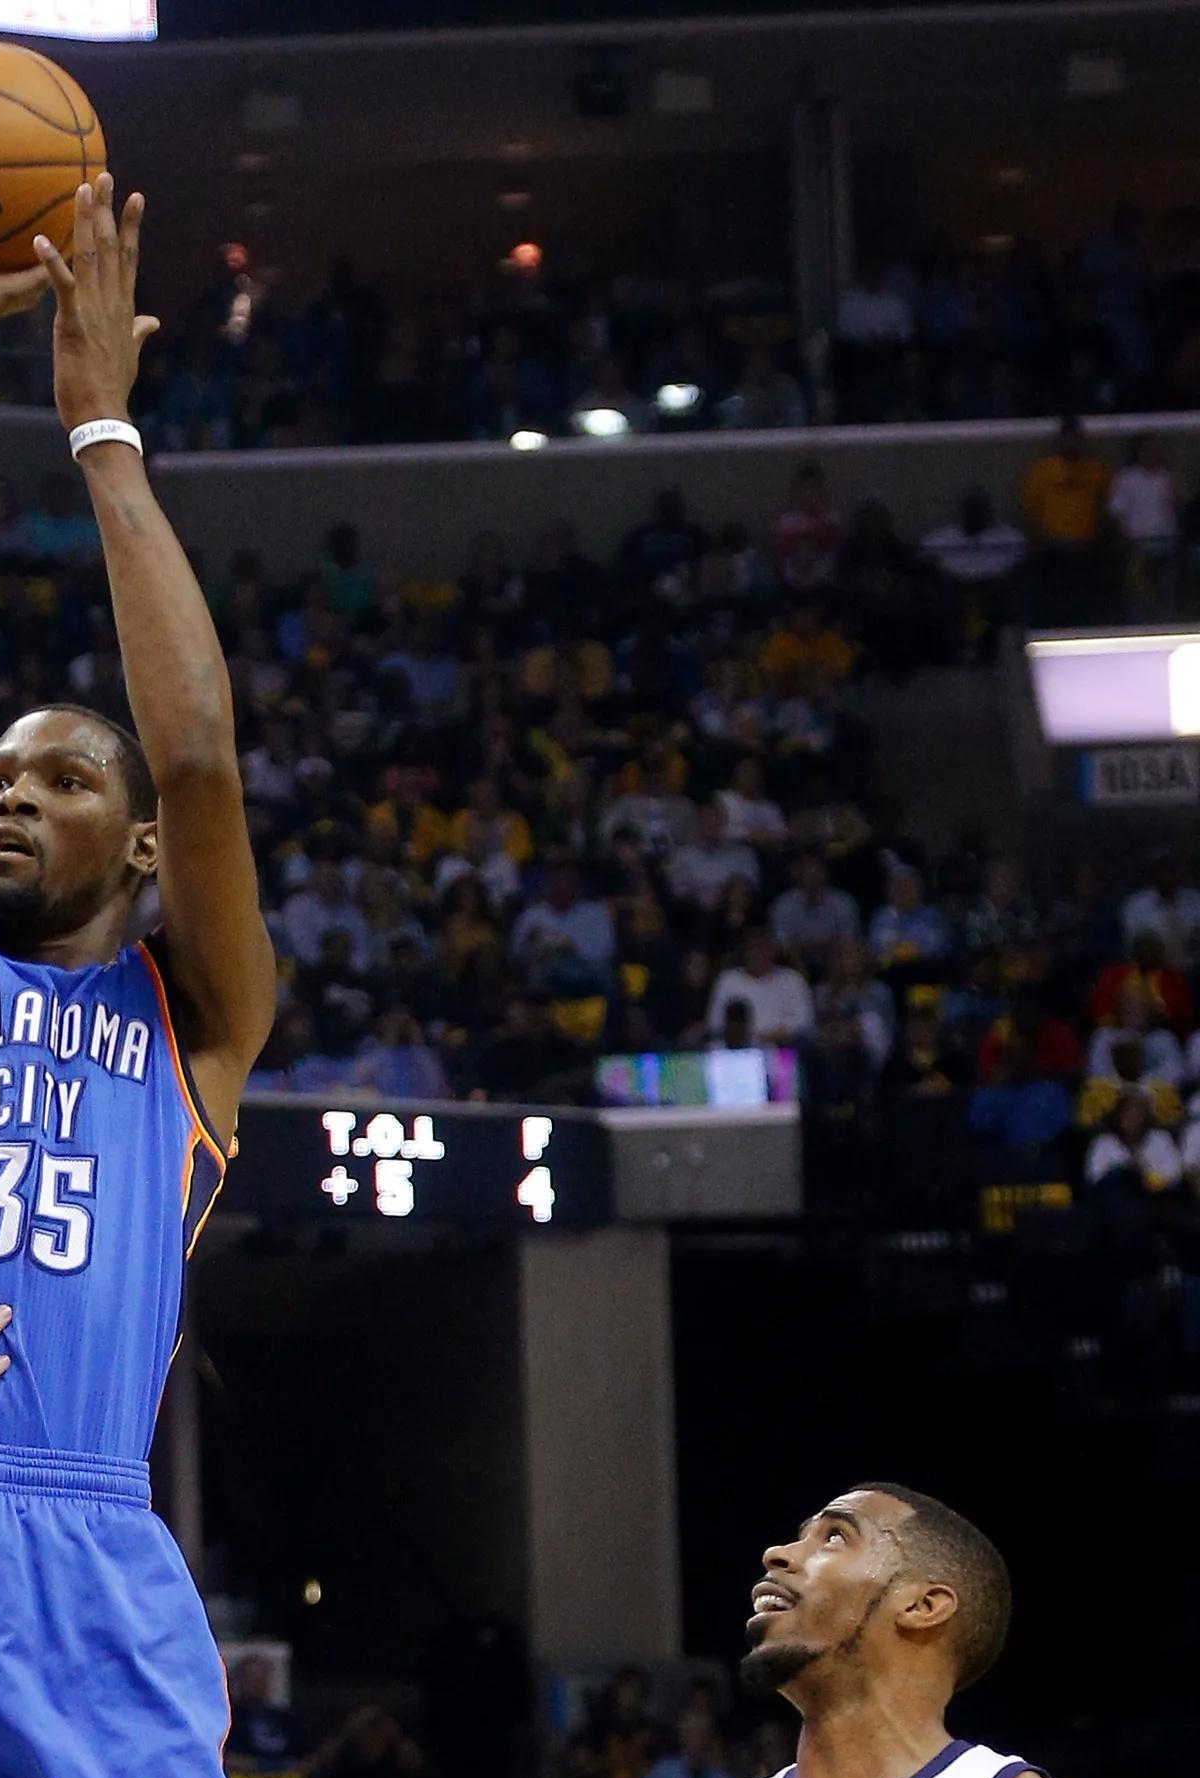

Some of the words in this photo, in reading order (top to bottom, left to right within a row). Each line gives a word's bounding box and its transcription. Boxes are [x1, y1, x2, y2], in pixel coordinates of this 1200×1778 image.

[521, 1116, 553, 1161] F
[375, 1159, 415, 1217] 5
[516, 1165, 555, 1223] 4
